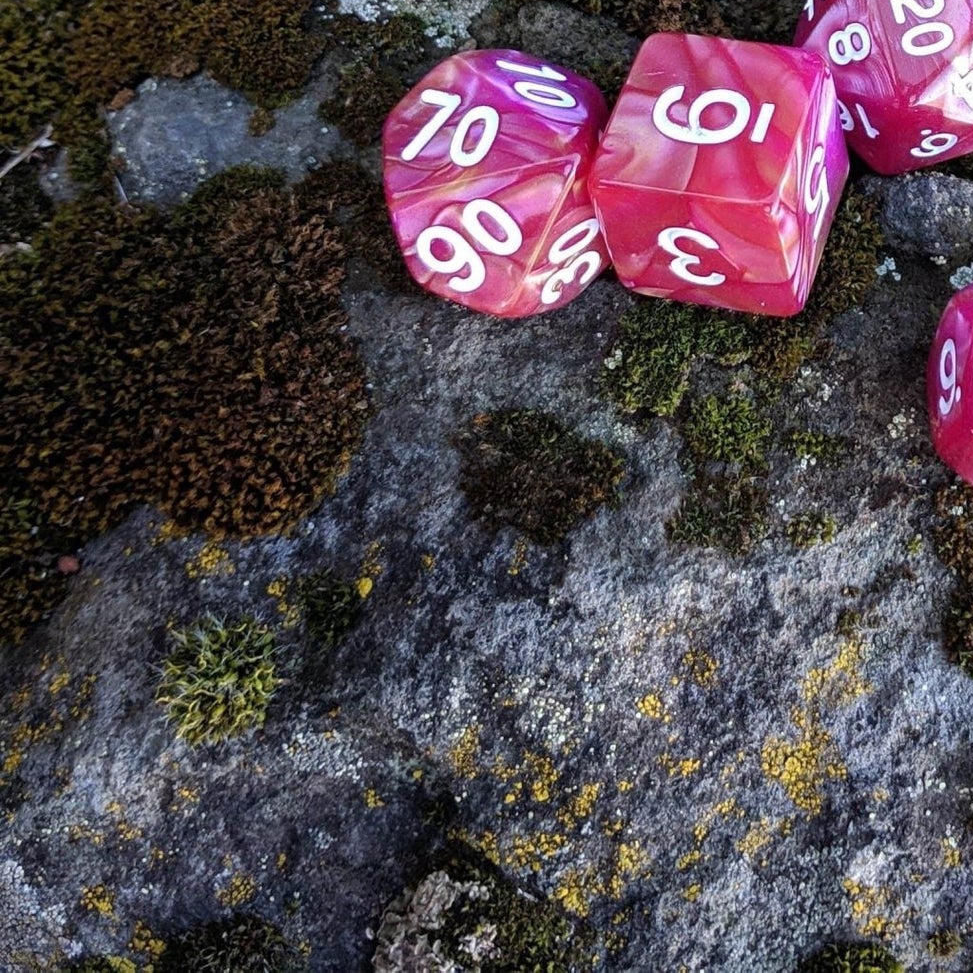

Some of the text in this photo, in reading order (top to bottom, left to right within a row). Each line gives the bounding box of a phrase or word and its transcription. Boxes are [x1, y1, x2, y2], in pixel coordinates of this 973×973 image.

[828, 22, 871, 65] 8
[496, 59, 577, 109] 10
[401, 89, 500, 167] 70
[416, 198, 523, 293] 90
[657, 227, 726, 286] 3
